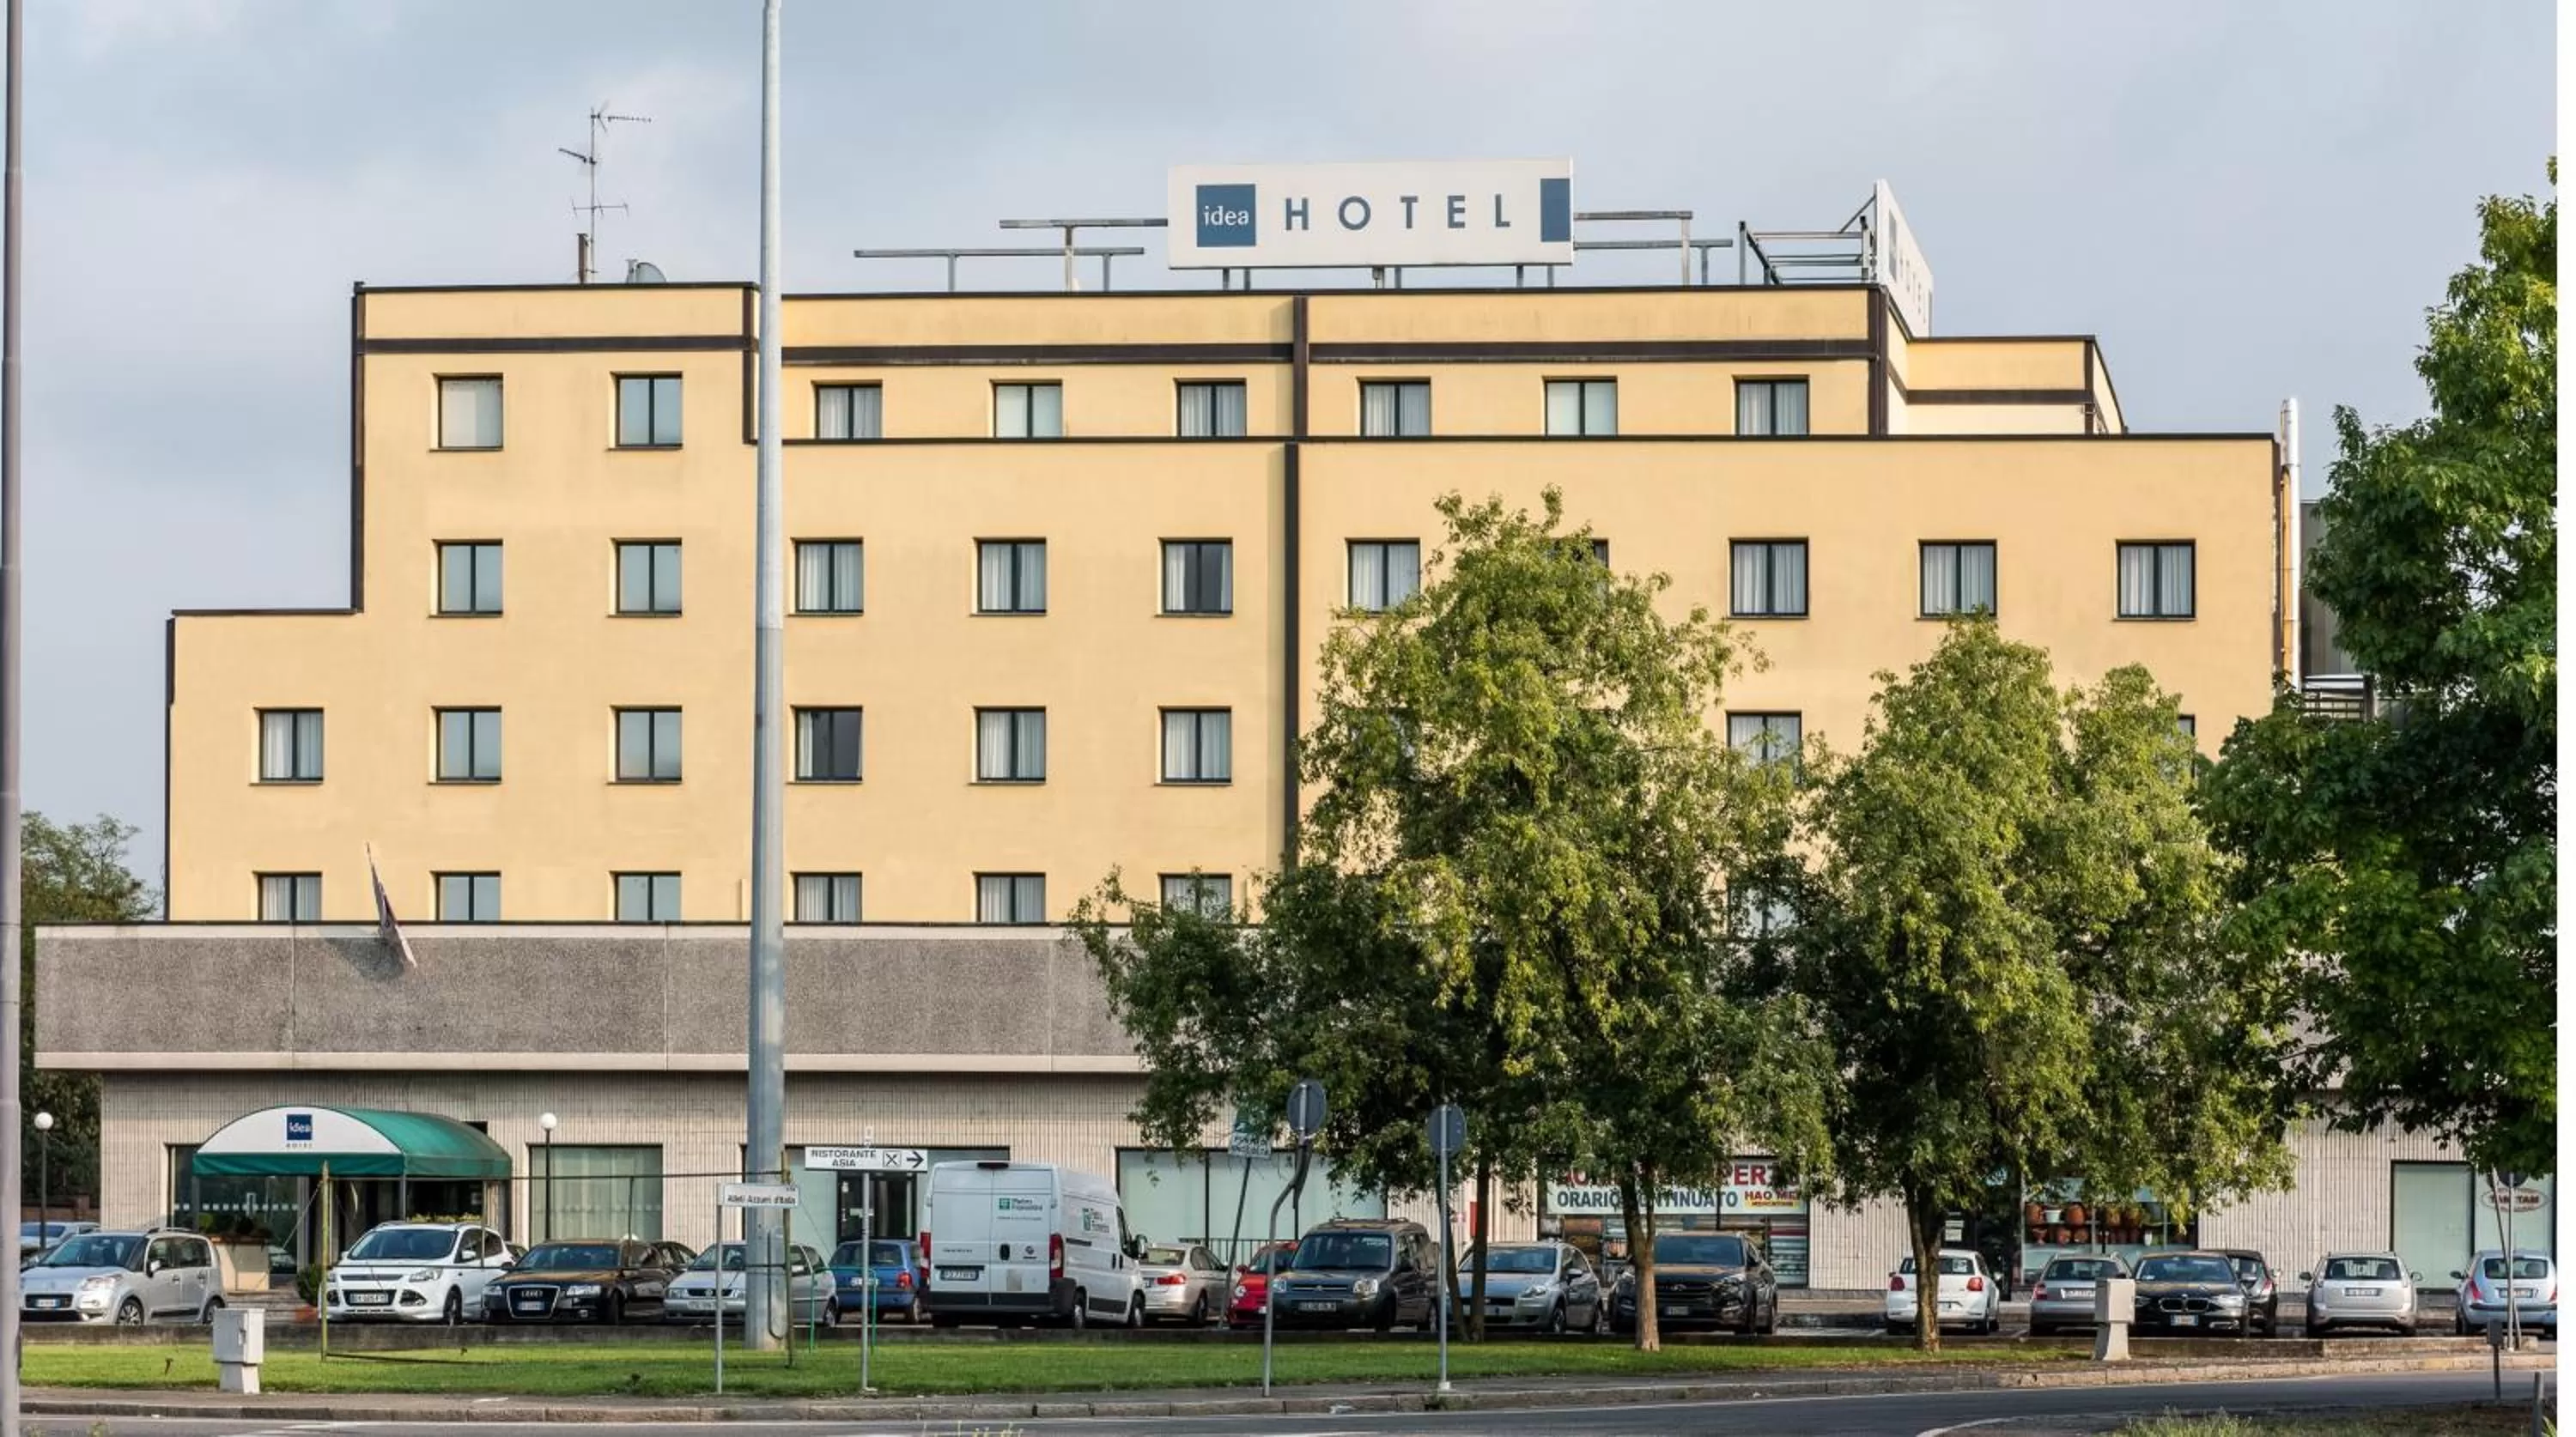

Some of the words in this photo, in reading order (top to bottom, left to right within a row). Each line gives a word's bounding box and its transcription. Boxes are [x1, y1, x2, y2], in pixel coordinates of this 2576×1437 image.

[1203, 205, 1249, 227] idea
[1285, 193, 1511, 231] HOTEL
[811, 1149, 877, 1159] RISTORANTE
[831, 1158, 857, 1167] ASIA
[1557, 1190, 1620, 1208] ORARIO
